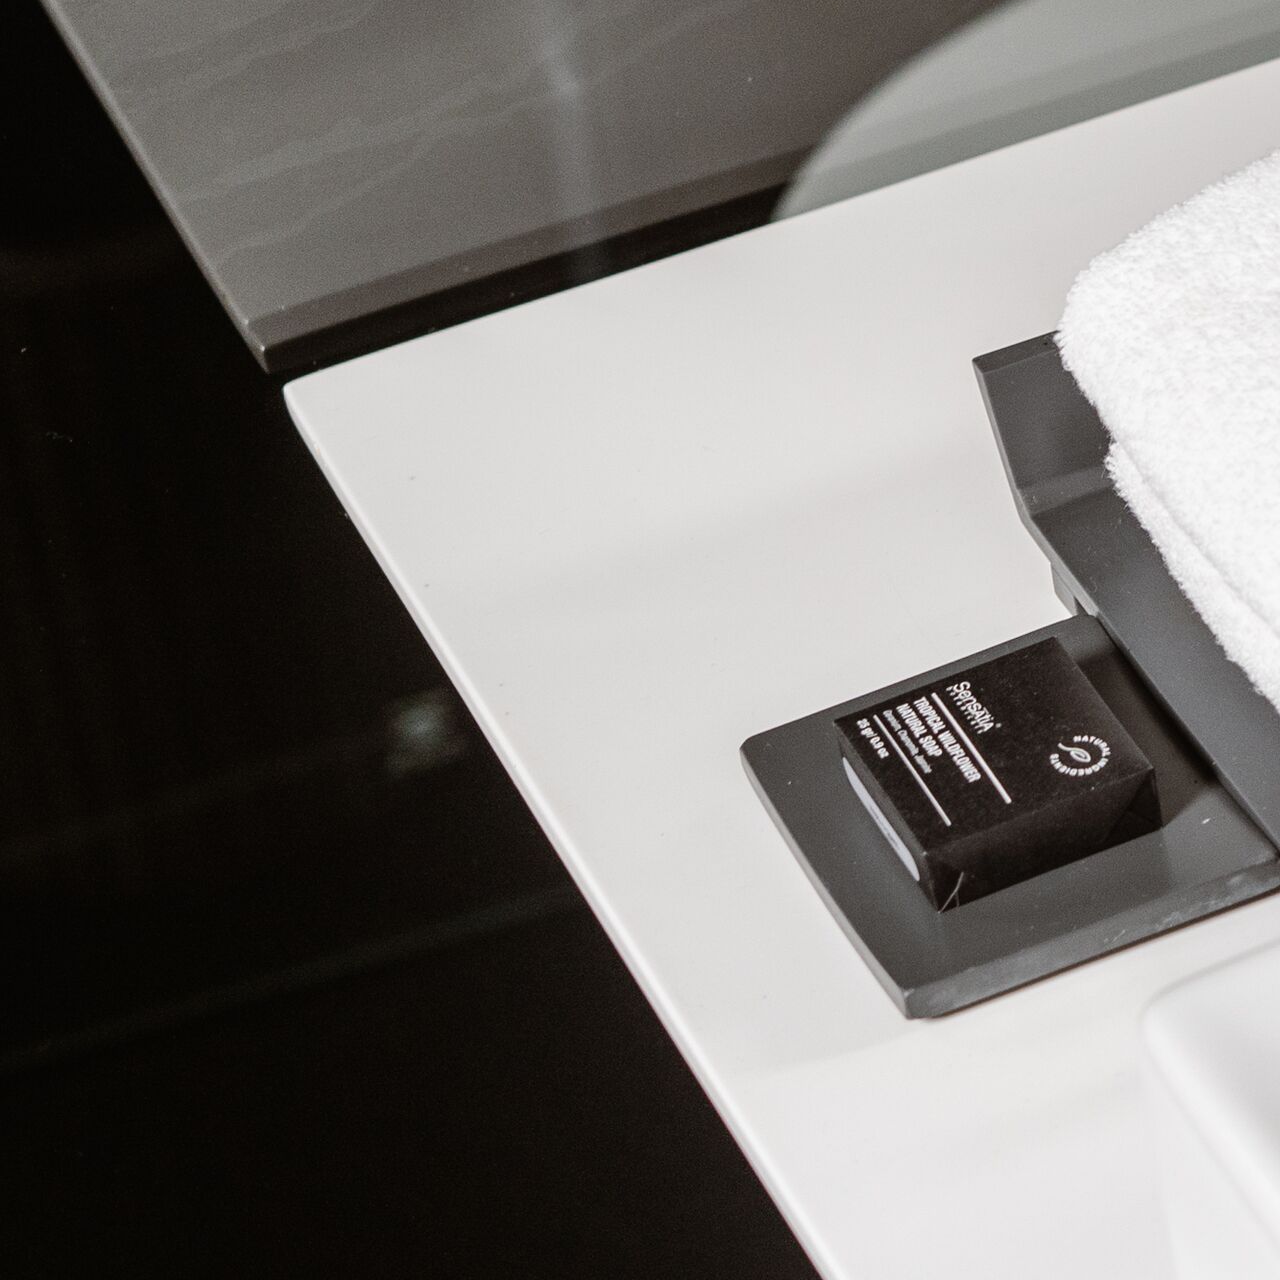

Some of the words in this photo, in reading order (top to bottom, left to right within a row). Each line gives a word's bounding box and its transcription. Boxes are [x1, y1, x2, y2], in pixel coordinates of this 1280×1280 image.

[896, 703, 927, 738] NATURAL
[919, 735, 943, 757] SOAP
[913, 696, 946, 734] TROPICAL
[938, 730, 981, 783] WILDFLOWER
